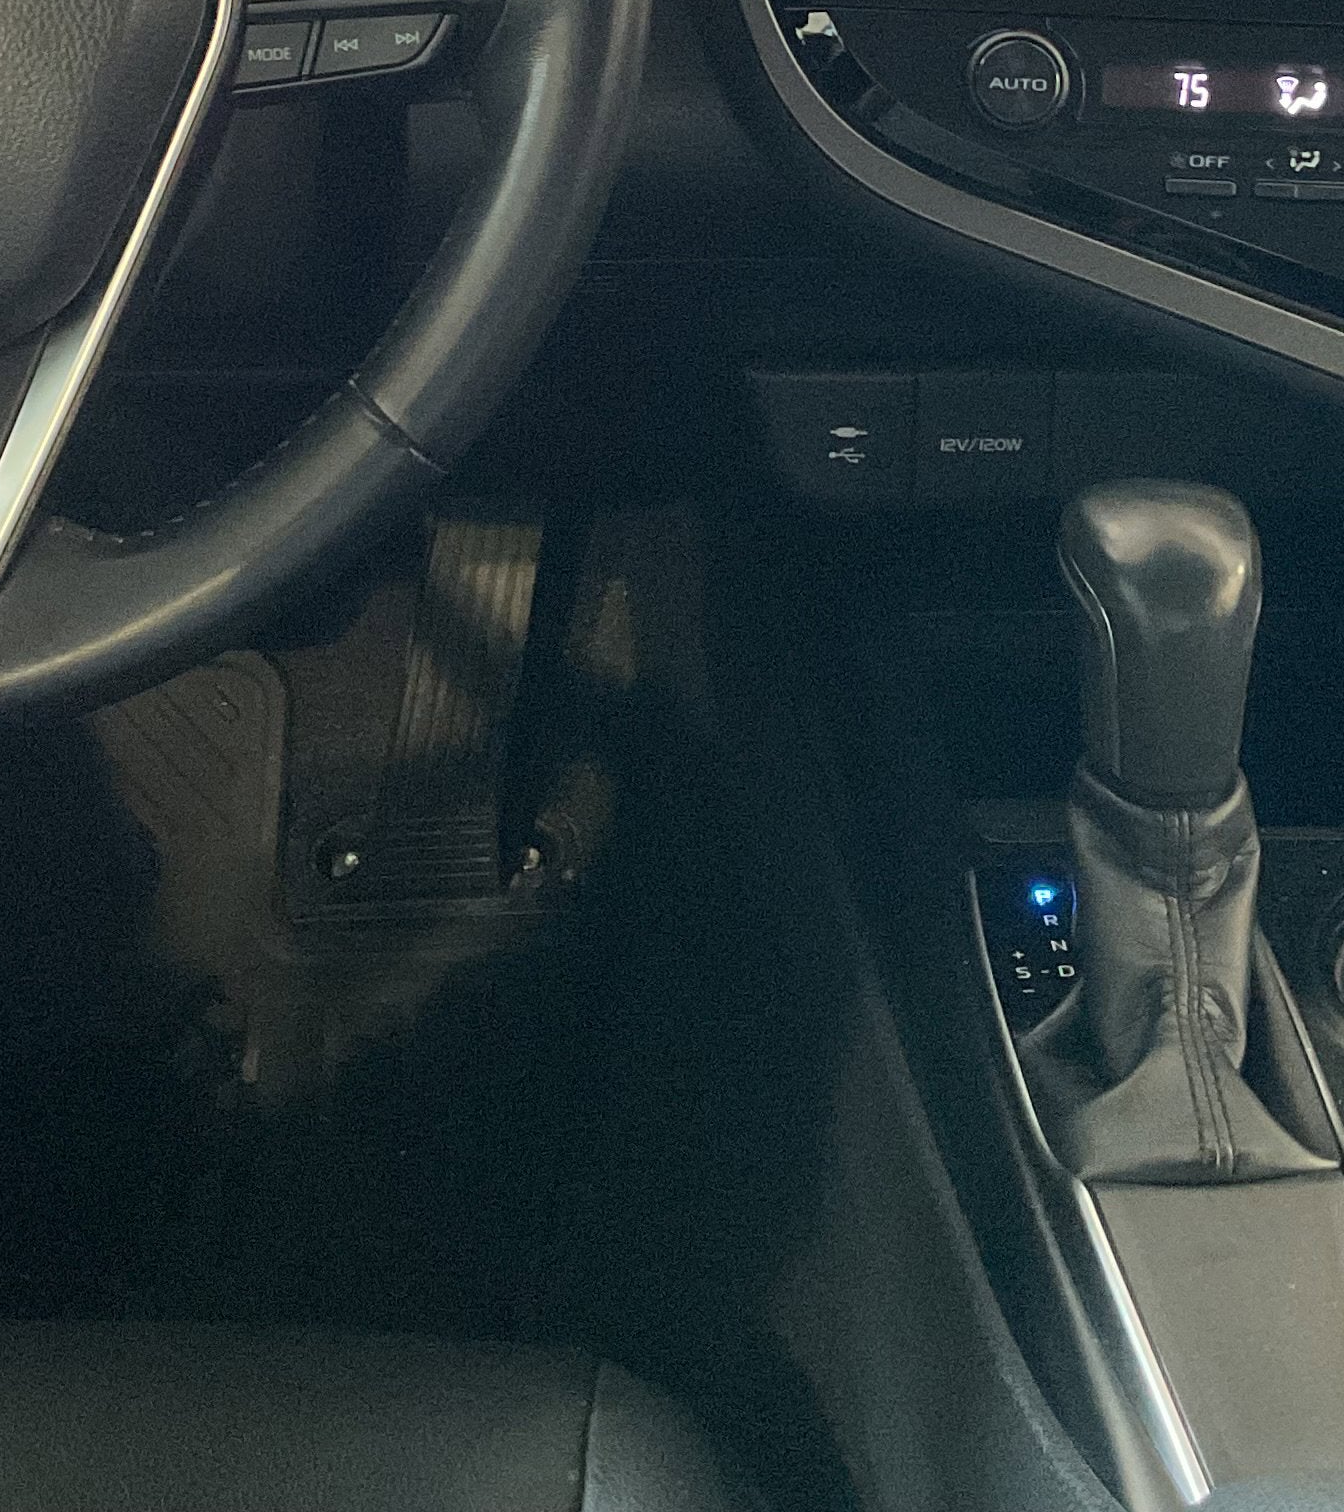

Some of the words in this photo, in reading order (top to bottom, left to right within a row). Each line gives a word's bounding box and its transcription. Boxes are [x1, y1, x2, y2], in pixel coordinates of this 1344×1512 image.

[247, 46, 293, 63] MODE
[989, 76, 1048, 92] AUTO
[1173, 72, 1209, 109] 75
[1188, 154, 1231, 169] OFF
[939, 437, 1023, 453] 12V/120W
[1033, 888, 1053, 907] P
[1042, 914, 1059, 927] R
[1050, 939, 1068, 953] N
[1015, 966, 1032, 980] S
[1057, 964, 1075, 978] D
